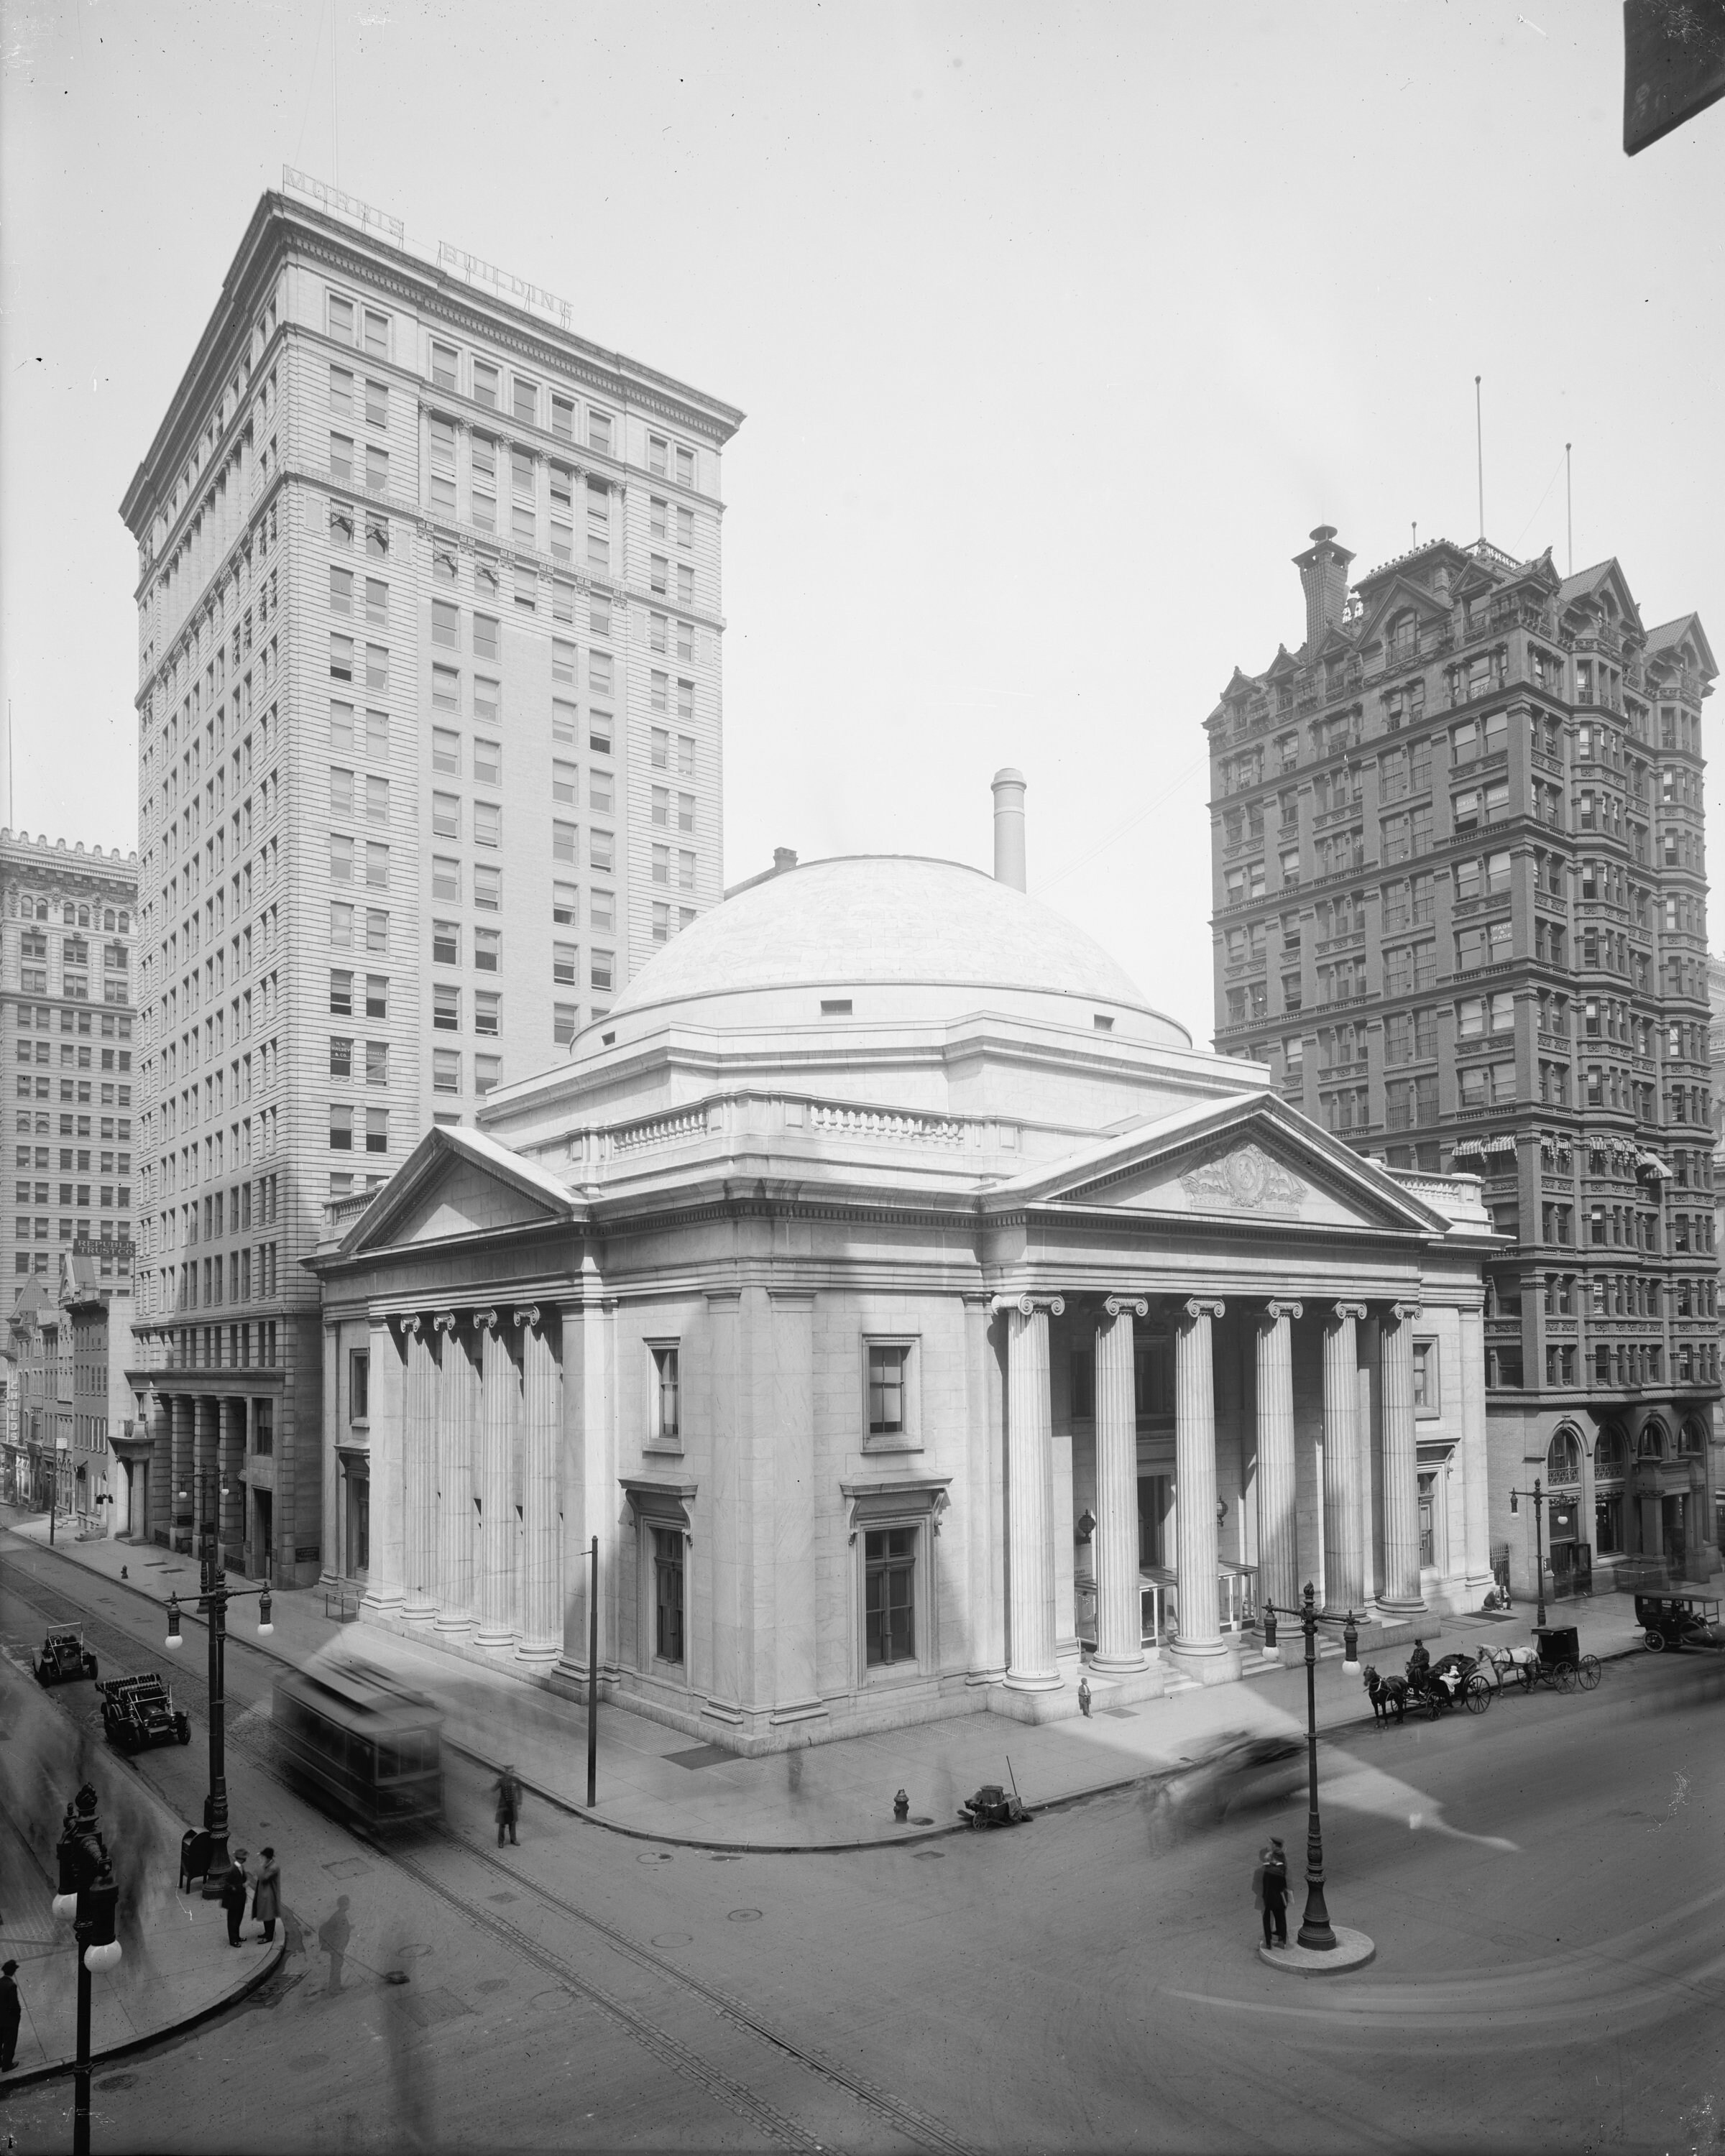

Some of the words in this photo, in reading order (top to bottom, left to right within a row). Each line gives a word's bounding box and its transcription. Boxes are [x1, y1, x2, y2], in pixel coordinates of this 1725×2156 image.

[286, 166, 403, 238] MORRIS
[443, 242, 574, 321] BUILDING
[78, 1240, 136, 1249] REPUBLIC
[79, 1246, 116, 1255] TRUST
[10, 1381, 19, 1441] CHILDS
